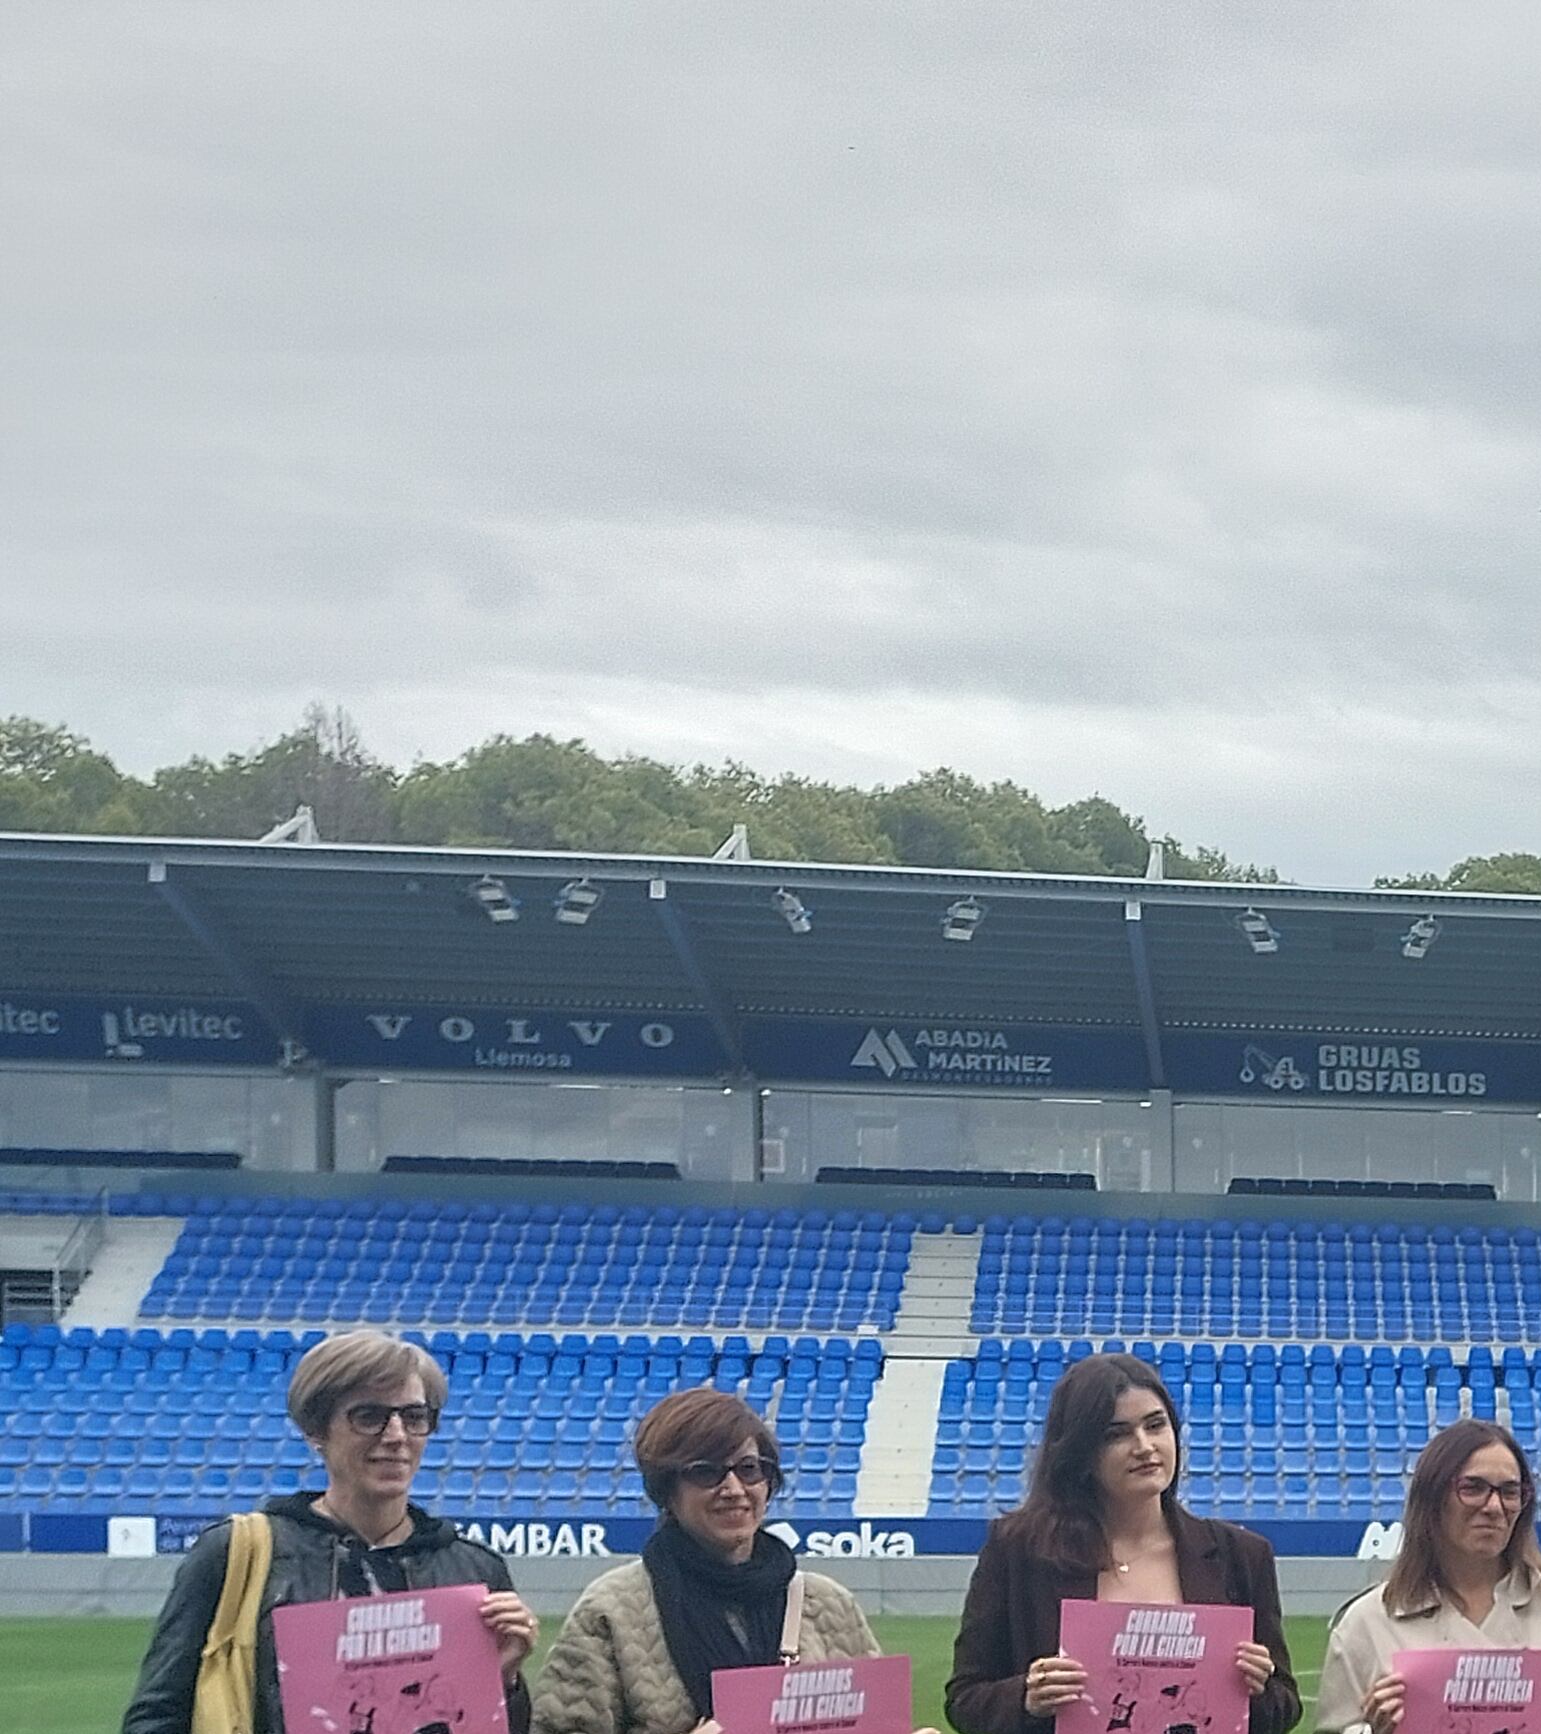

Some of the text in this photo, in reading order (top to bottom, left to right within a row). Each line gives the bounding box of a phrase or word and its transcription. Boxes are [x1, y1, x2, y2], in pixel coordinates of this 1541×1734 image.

[365, 1013, 675, 1048] VOLVO
[1318, 1045, 1421, 1070] GRUAS
[1318, 1070, 1486, 1095] LOSFABLOS
[806, 1521, 915, 1558] soka
[1126, 1610, 1196, 1634] CORRAMOS
[1112, 1633, 1205, 1658] POR LA CIENCIA
[1456, 1656, 1523, 1679] CORRAMOS
[1444, 1680, 1533, 1703] POR LA CIENCIA
